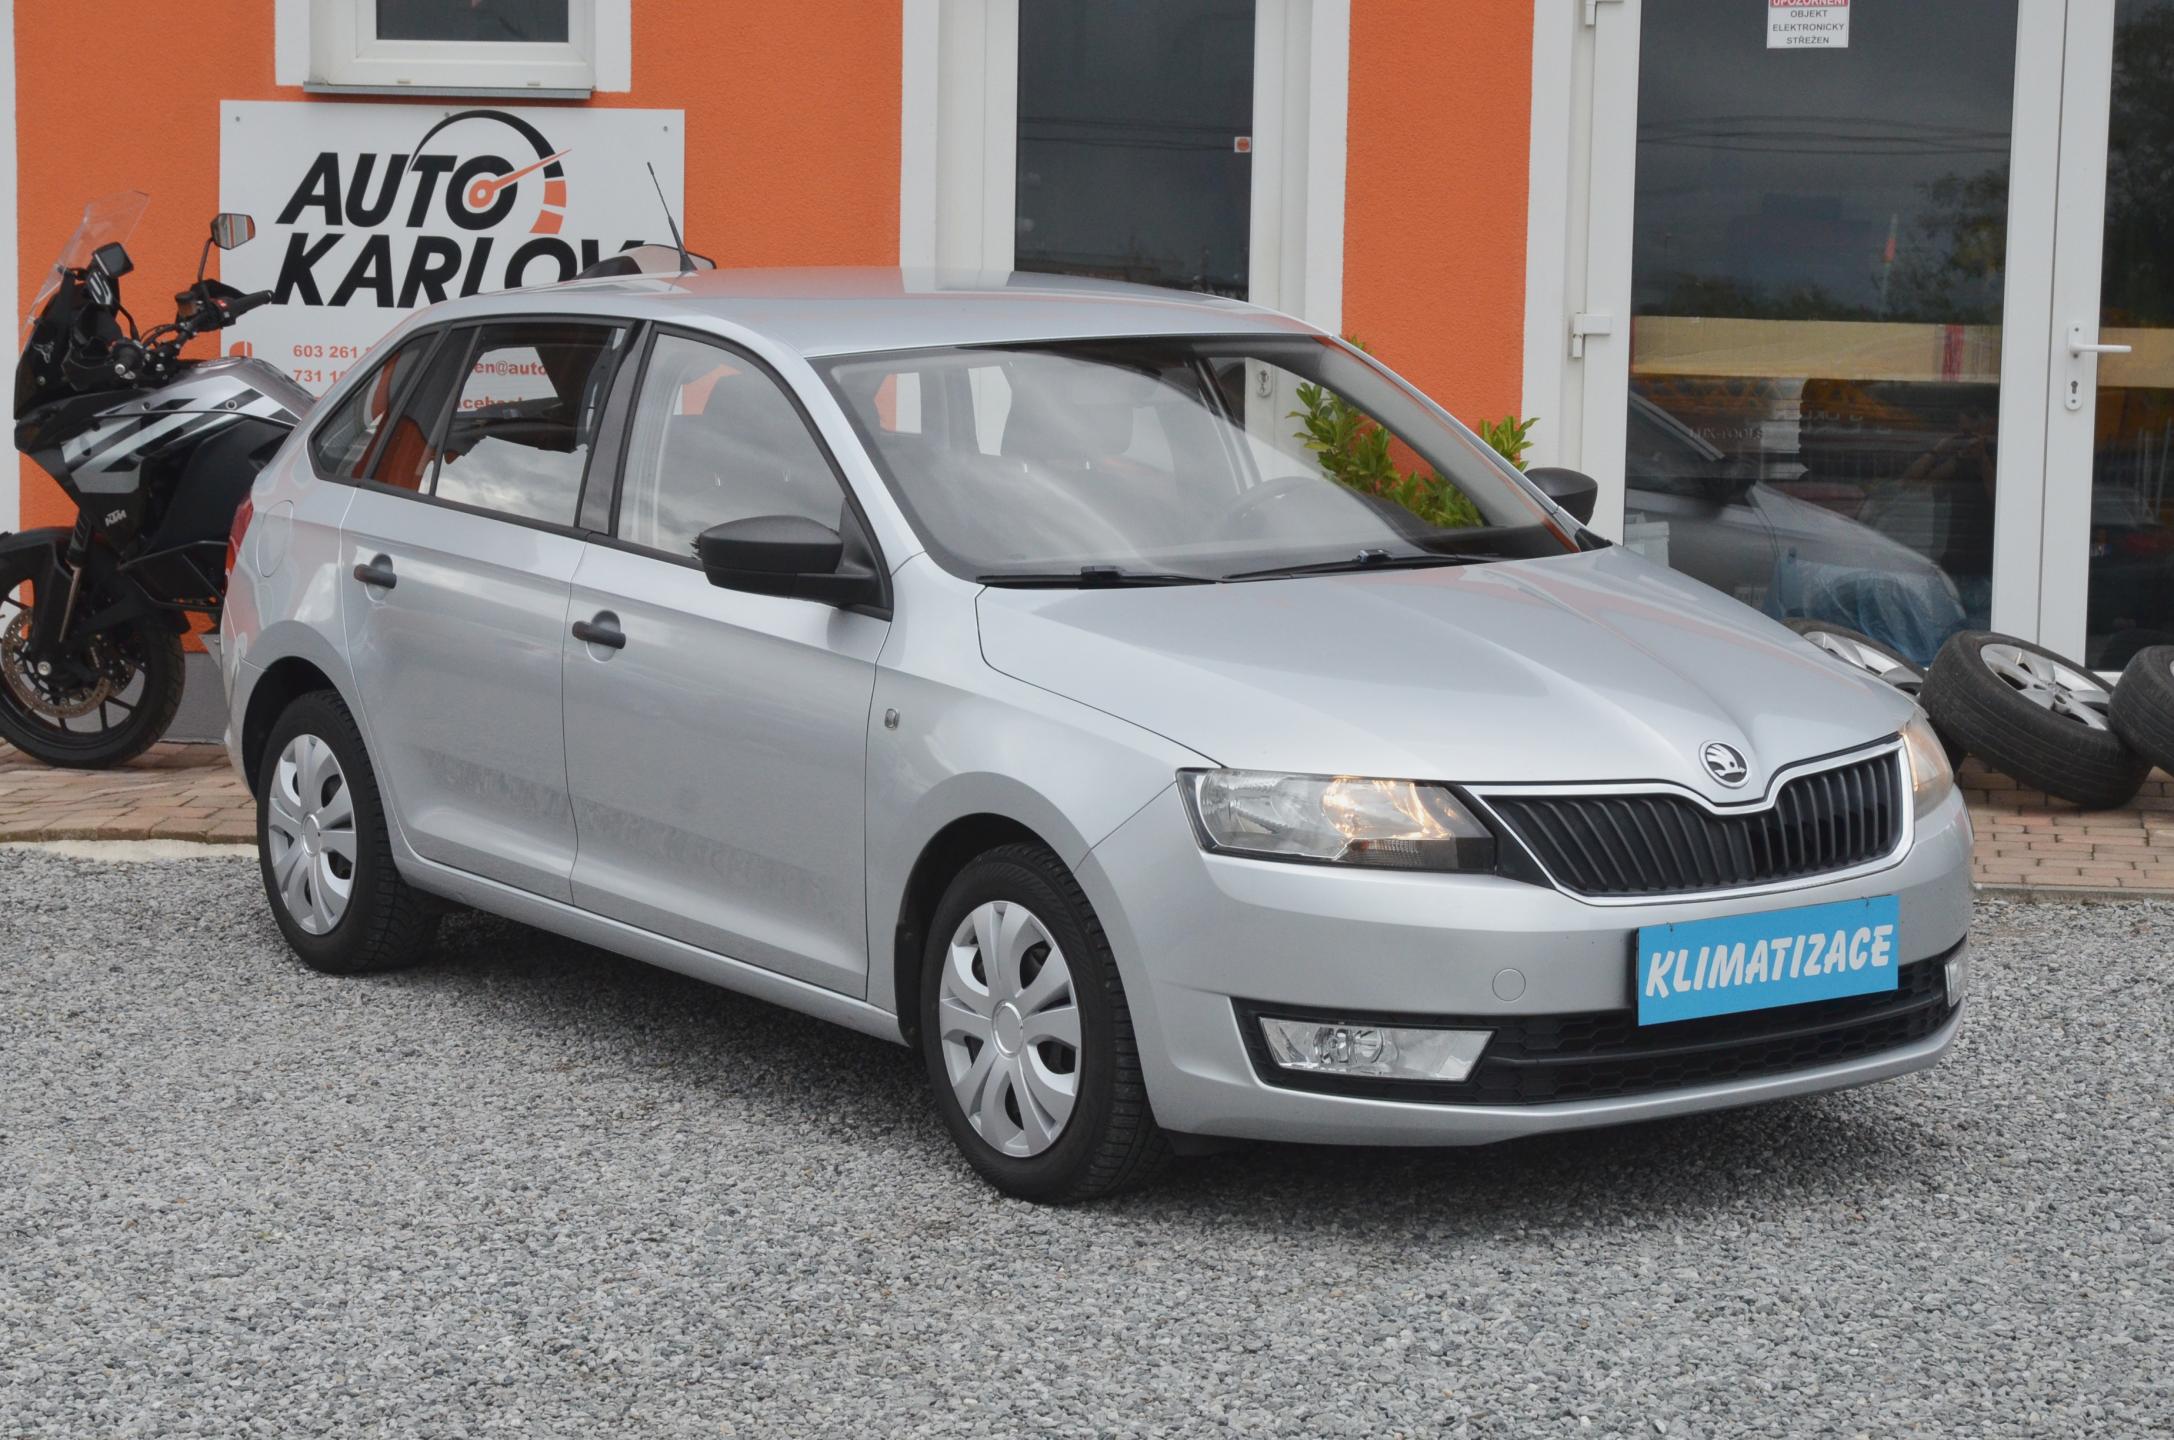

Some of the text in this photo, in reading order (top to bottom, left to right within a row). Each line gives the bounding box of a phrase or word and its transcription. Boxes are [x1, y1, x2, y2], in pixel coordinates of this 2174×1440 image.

[1790, 10, 1828, 18] OBJEKT
[1772, 23, 1845, 32] ELEKTRONICKY
[1786, 36, 1830, 44] STŘEŽEN
[275, 152, 518, 230] AUTO
[293, 345, 324, 358] 603
[329, 346, 357, 358] 261
[293, 369, 322, 382] 731
[104, 509, 127, 527] KTM
[1645, 924, 1894, 998] KLIMATIZACE
